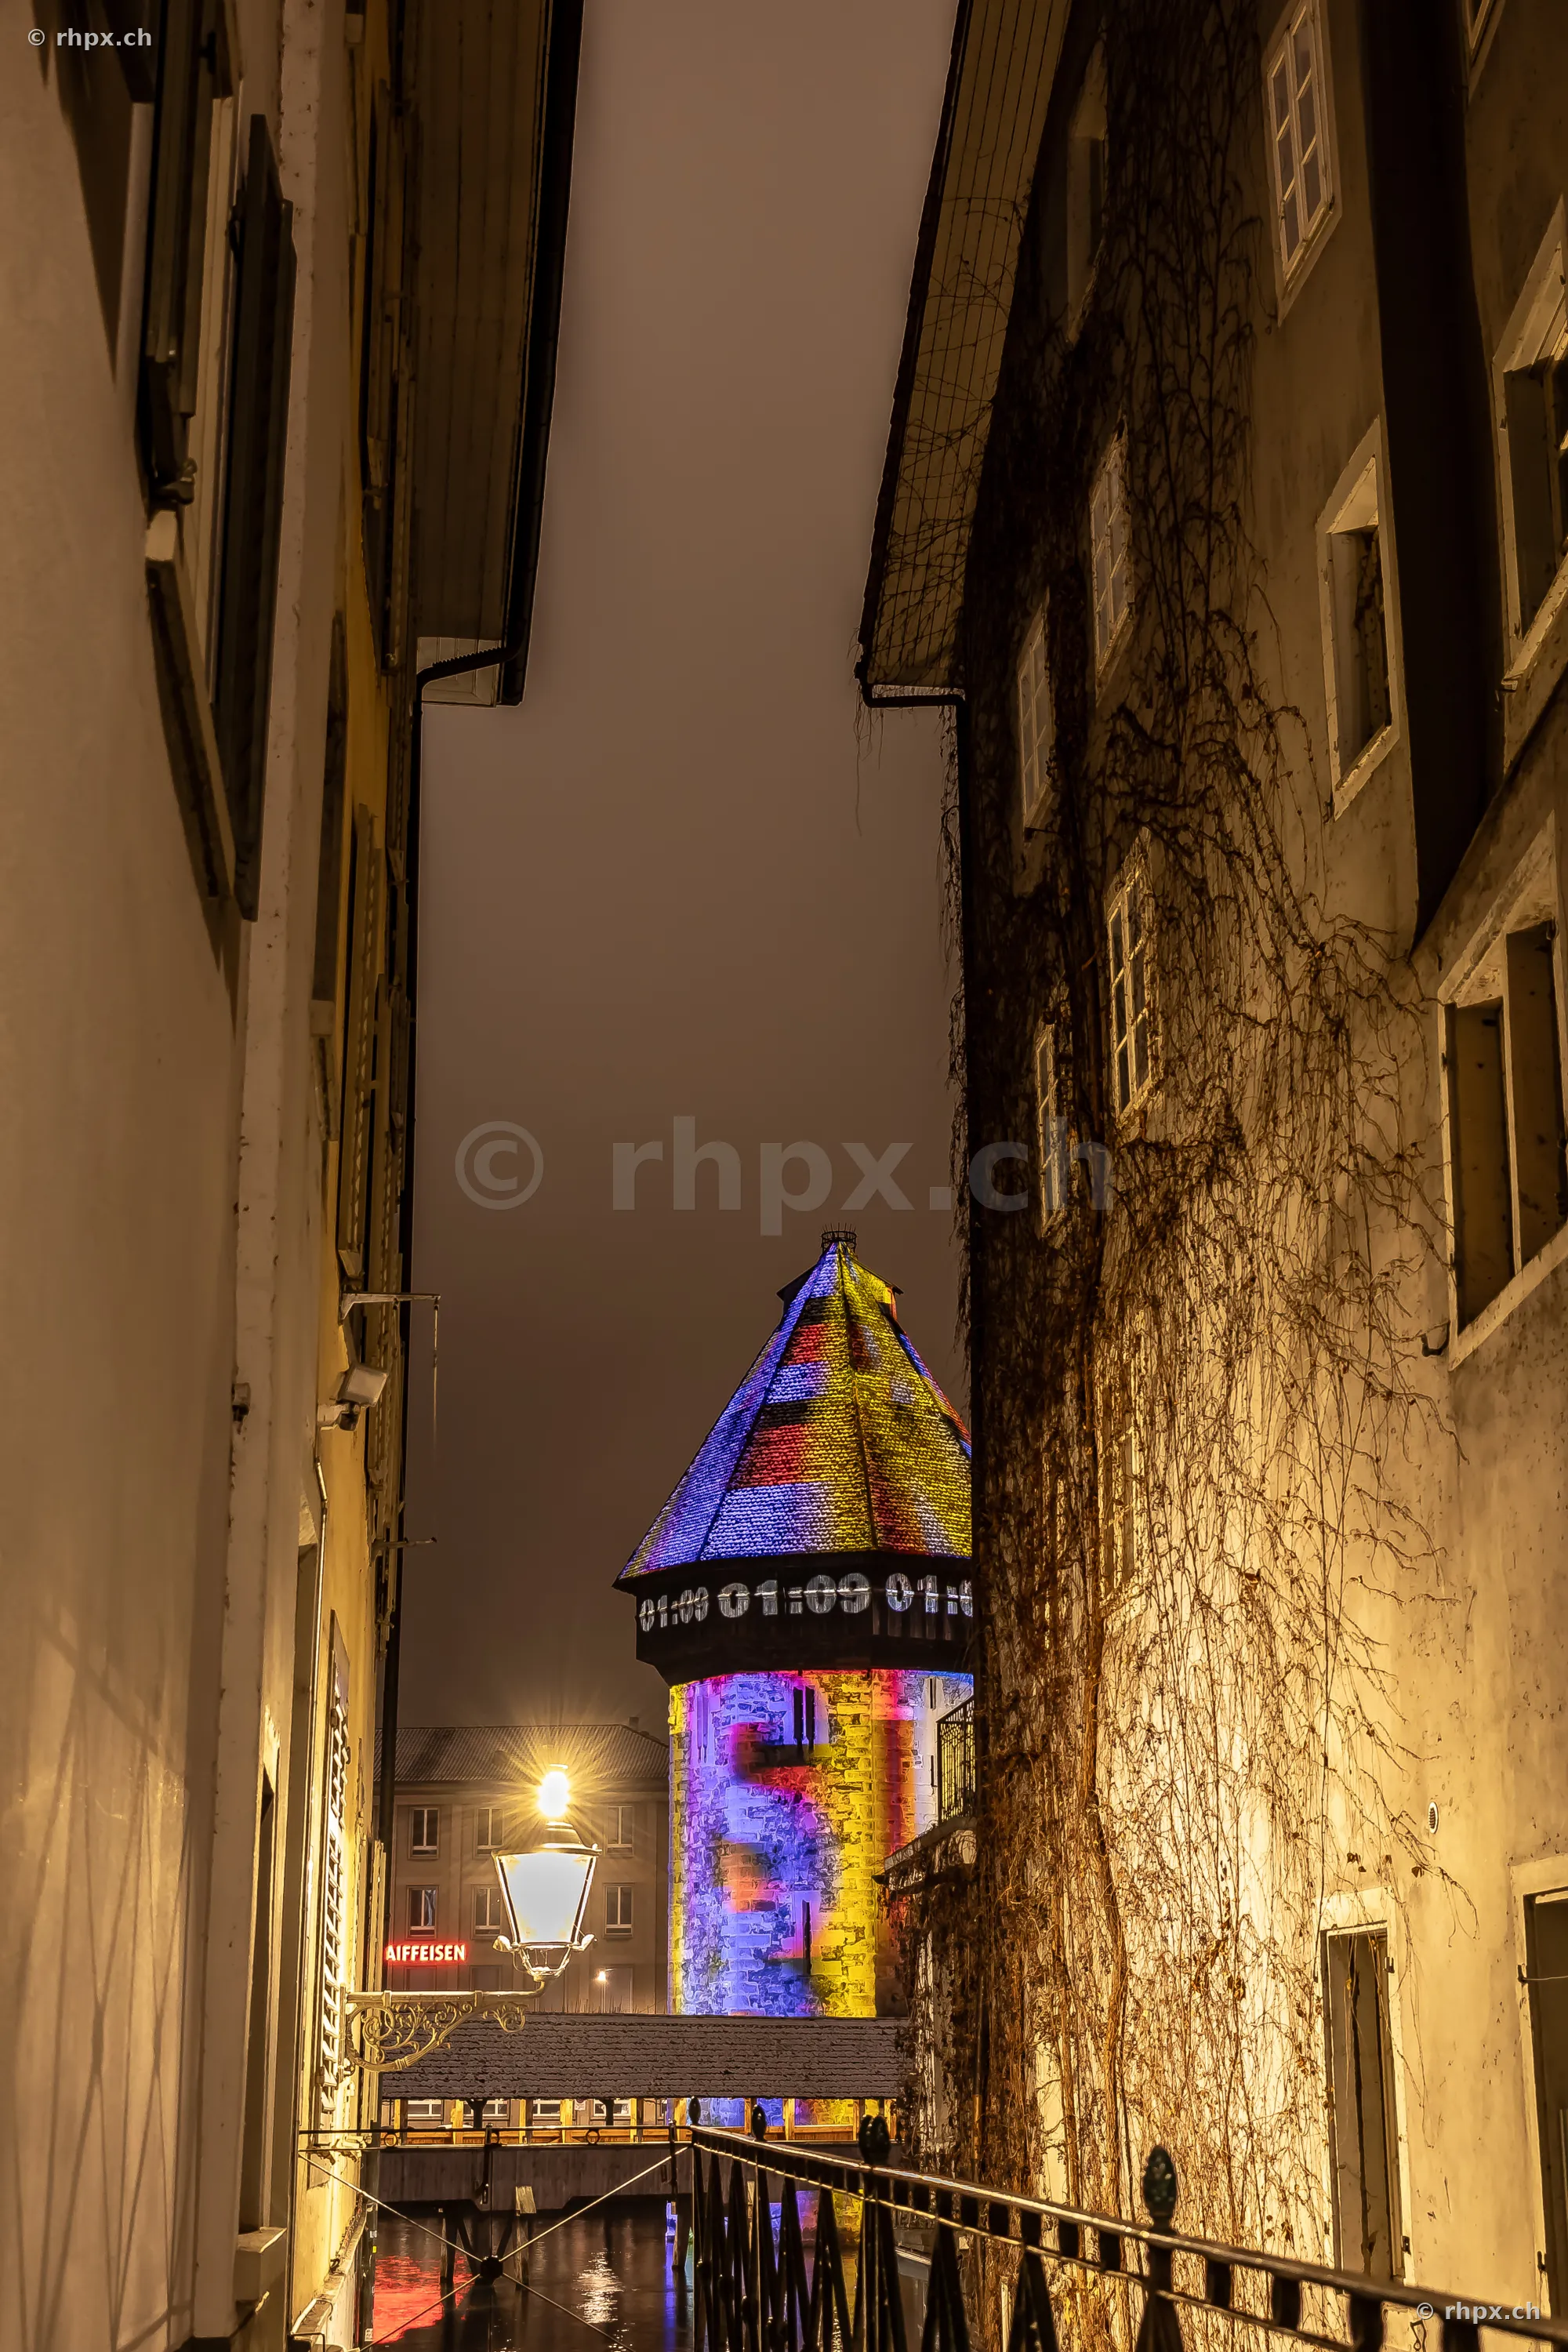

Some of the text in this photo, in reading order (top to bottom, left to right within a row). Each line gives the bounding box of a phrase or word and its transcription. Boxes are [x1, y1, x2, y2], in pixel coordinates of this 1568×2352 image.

[639, 1586, 709, 1632] 01:09
[717, 1573, 871, 1618] 01:09
[386, 1944, 466, 1962] AIFFEISEN
